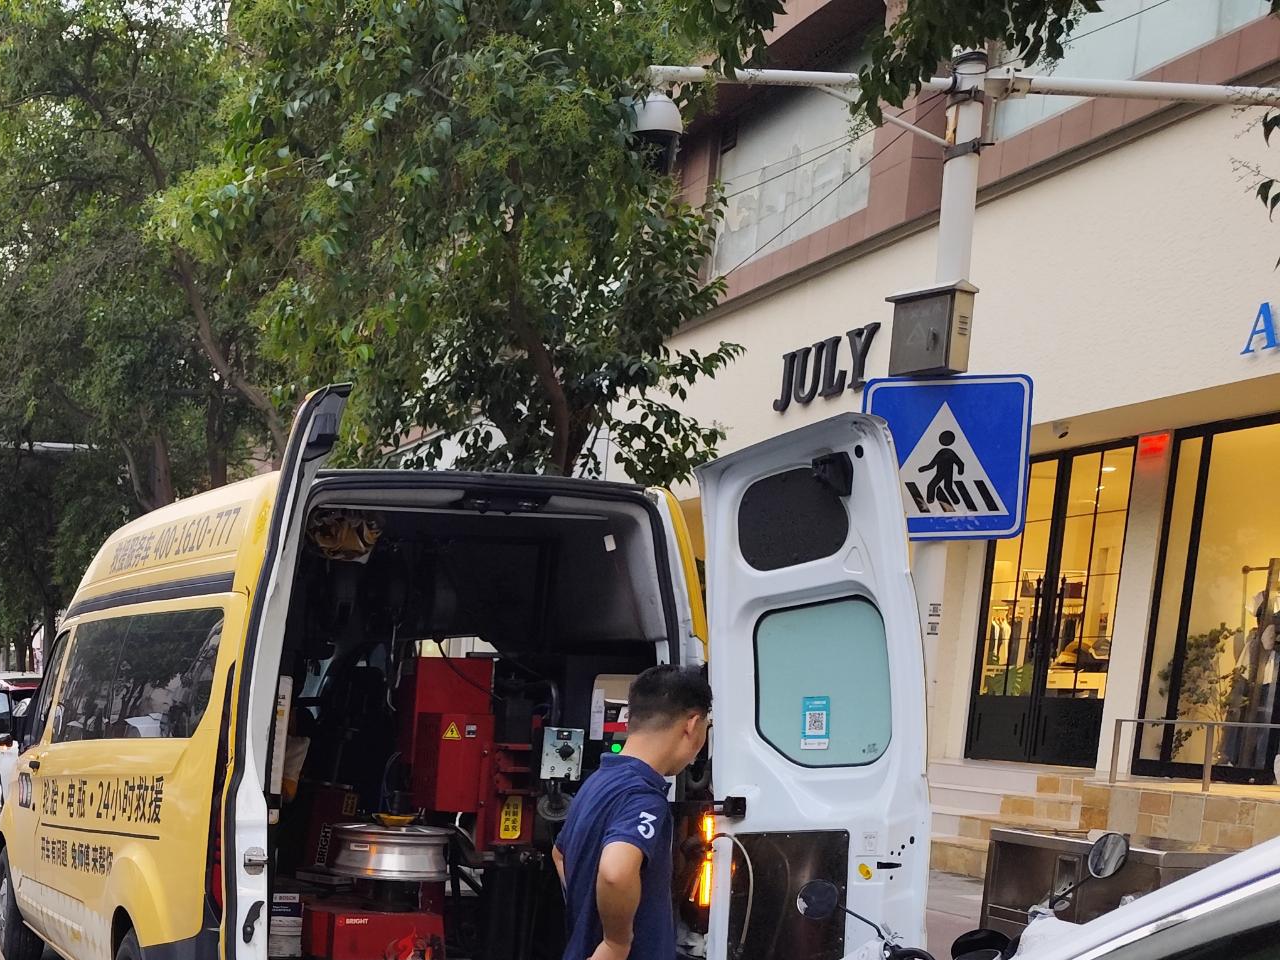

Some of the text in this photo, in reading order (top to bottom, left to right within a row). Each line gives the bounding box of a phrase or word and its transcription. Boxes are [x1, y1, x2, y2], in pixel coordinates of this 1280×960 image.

[1240, 302, 1280, 355] A
[773, 322, 881, 413] JULY
[153, 506, 242, 560] 400-1610-777
[637, 811, 657, 839] 3
